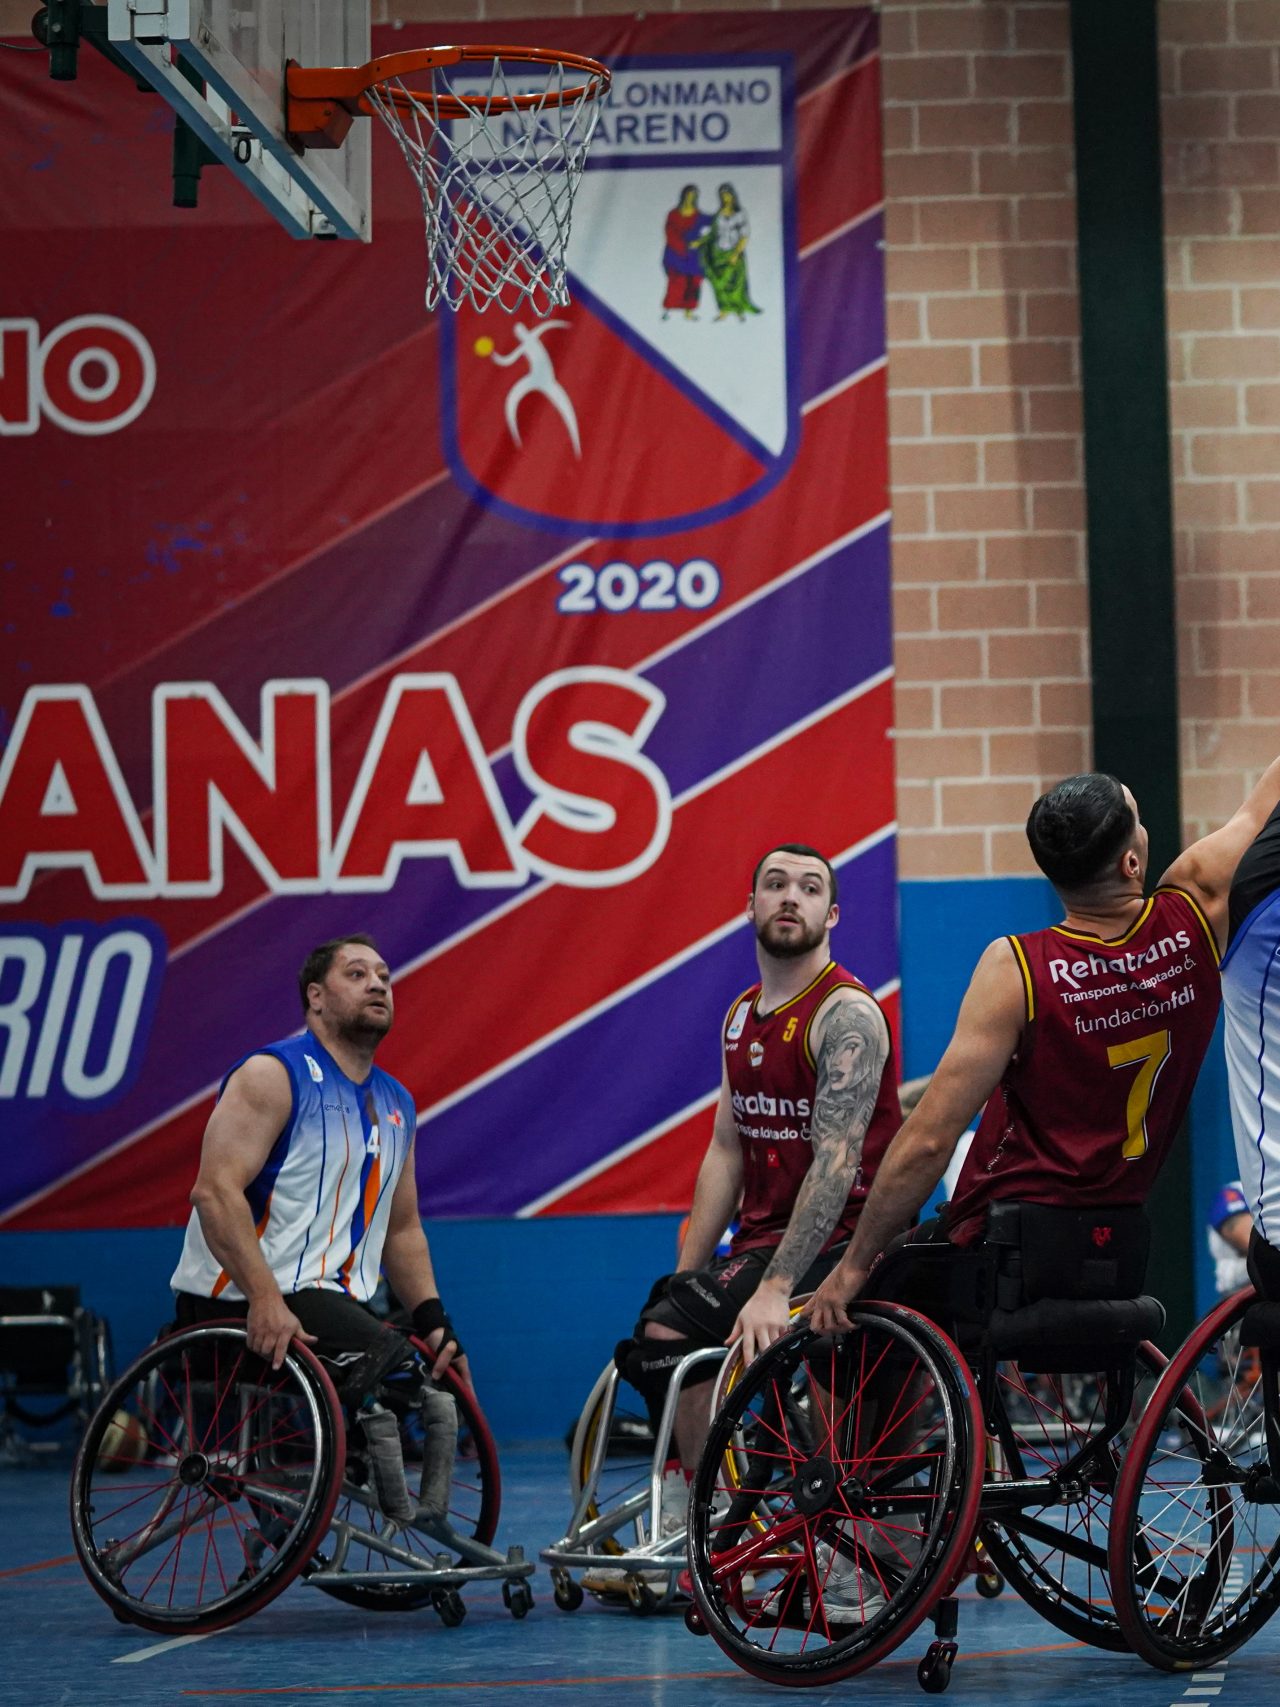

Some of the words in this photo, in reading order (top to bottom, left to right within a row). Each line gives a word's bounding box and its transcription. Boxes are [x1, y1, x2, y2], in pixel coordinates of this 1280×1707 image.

[562, 80, 771, 109] LONMANO
[503, 111, 730, 147] NAZARENO
[557, 559, 722, 614] 2020
[0, 666, 671, 902] ANAS
[1049, 930, 1191, 989] Rehatrans
[1060, 983, 1128, 1004] Transporte
[1130, 965, 1183, 991] Adaptado
[0, 930, 153, 1100] RIO
[782, 1017, 799, 1042] 5
[1075, 984, 1195, 1035] fundaciónfdi
[1108, 1029, 1172, 1161] 7
